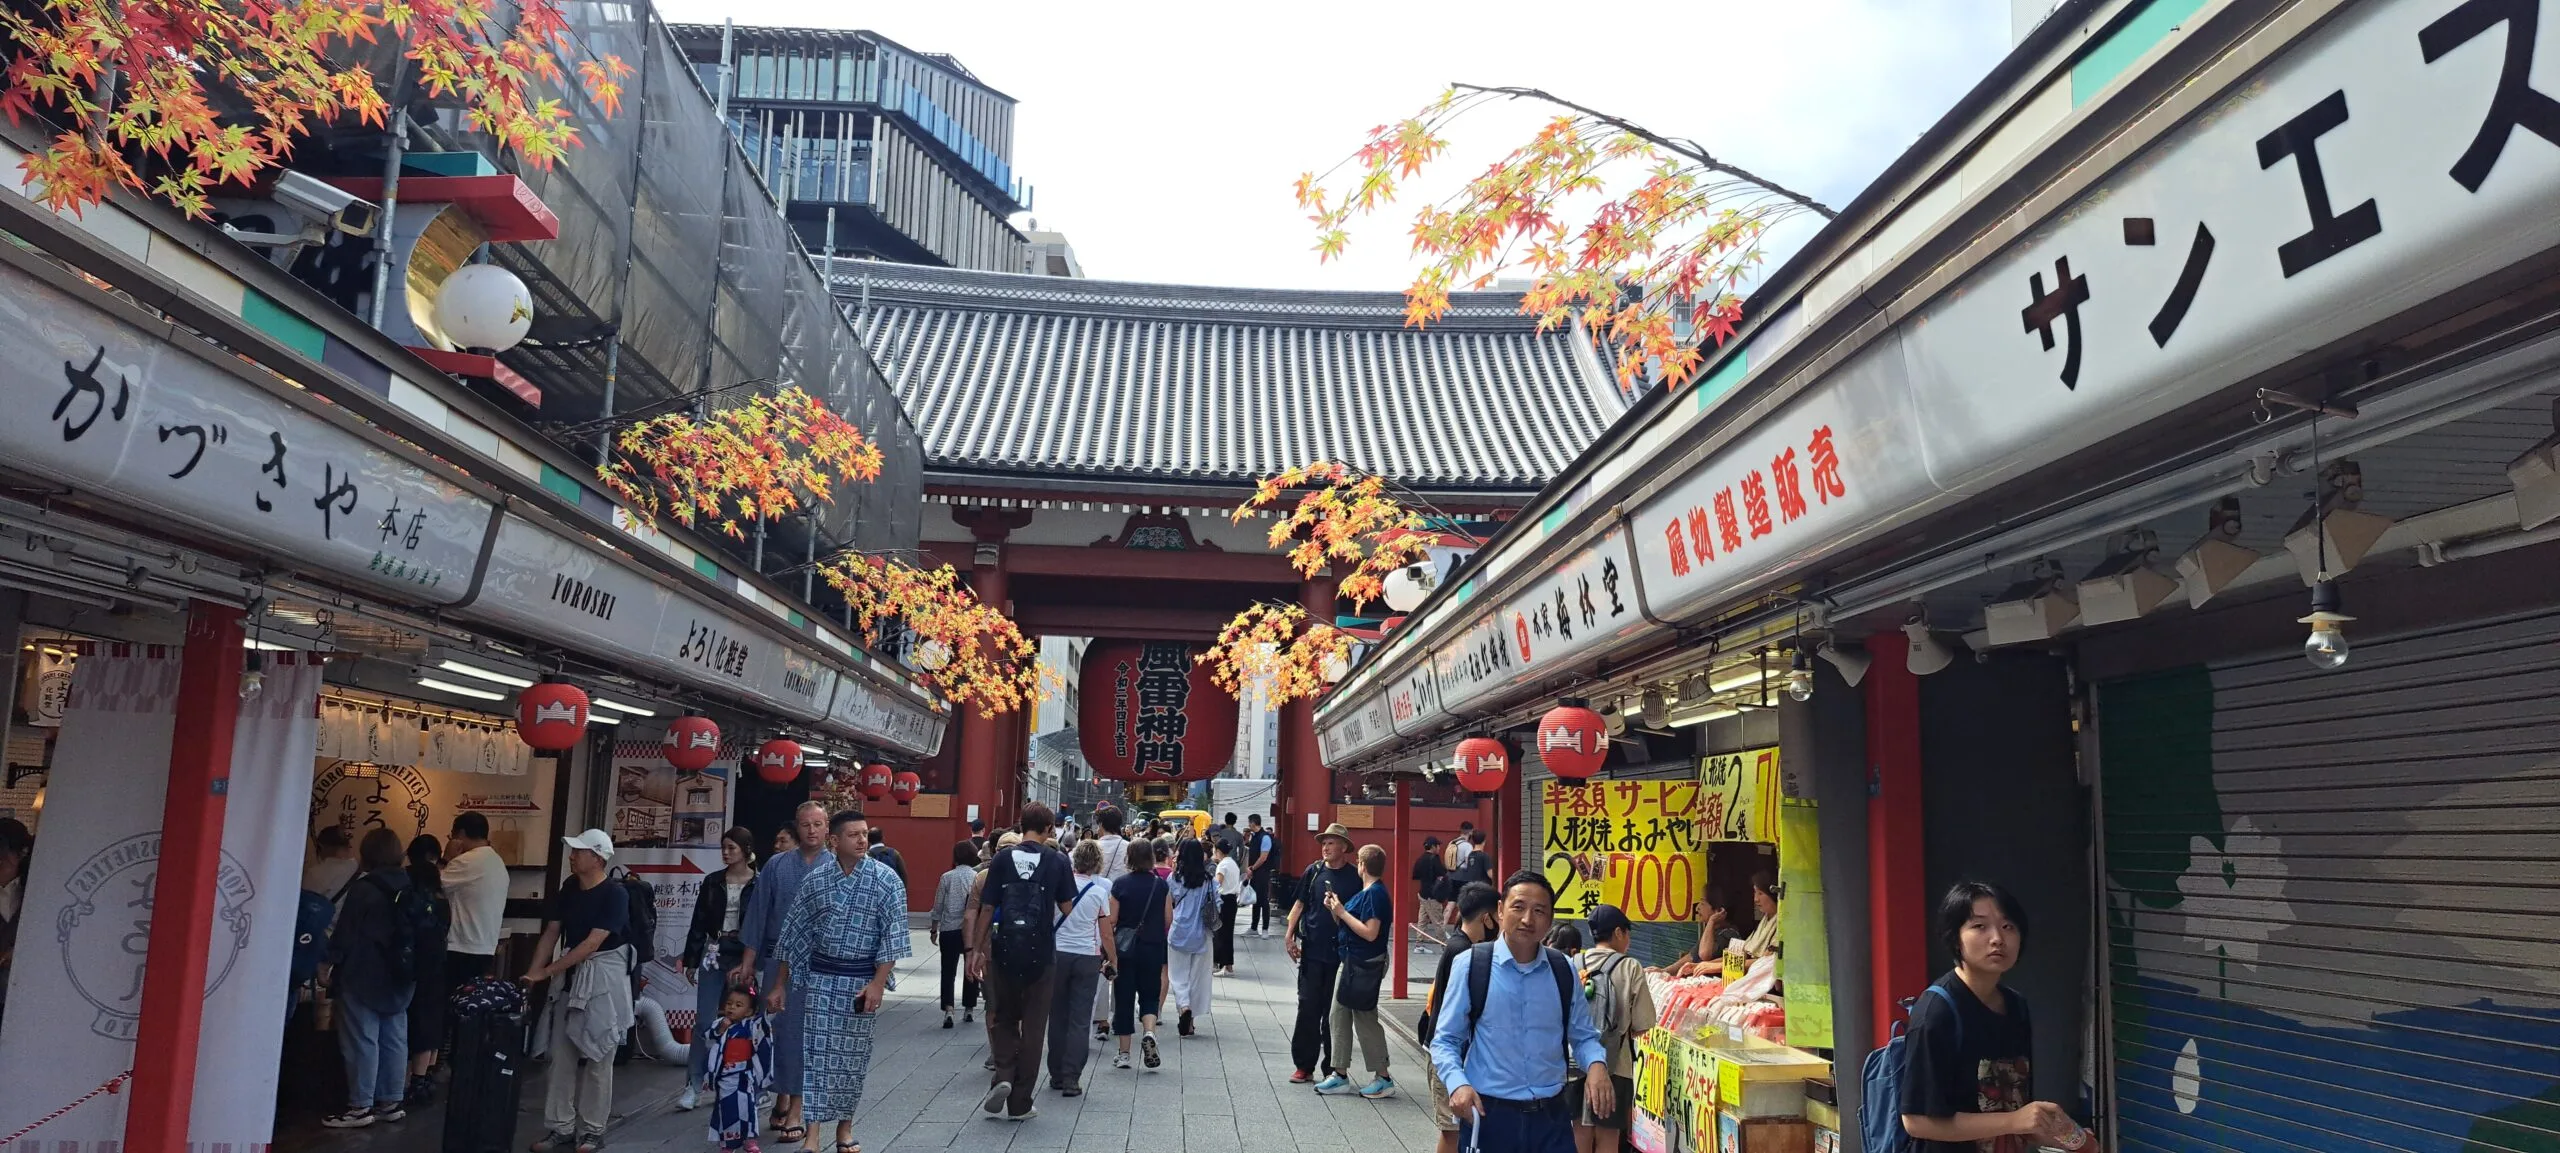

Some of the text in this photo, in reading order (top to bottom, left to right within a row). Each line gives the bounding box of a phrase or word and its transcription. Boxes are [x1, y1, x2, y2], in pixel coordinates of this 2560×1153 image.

[52, 346, 427, 550] かづきや 本店
[1665, 425, 1846, 577] 履物製造販売
[551, 573, 616, 620] YOROSHI
[1555, 556, 1624, 641] 梅林堂
[783, 670, 816, 698] COSMETICS
[1114, 660, 1131, 758] 令和二年四月吉日
[1544, 781, 1701, 817] 半額 サービス
[1699, 756, 1727, 787] 人形焼
[1724, 755, 1742, 839] 2
[1545, 816, 1614, 852] 人形焼
[1695, 792, 1723, 840] 半額
[1546, 852, 1577, 914] 2
